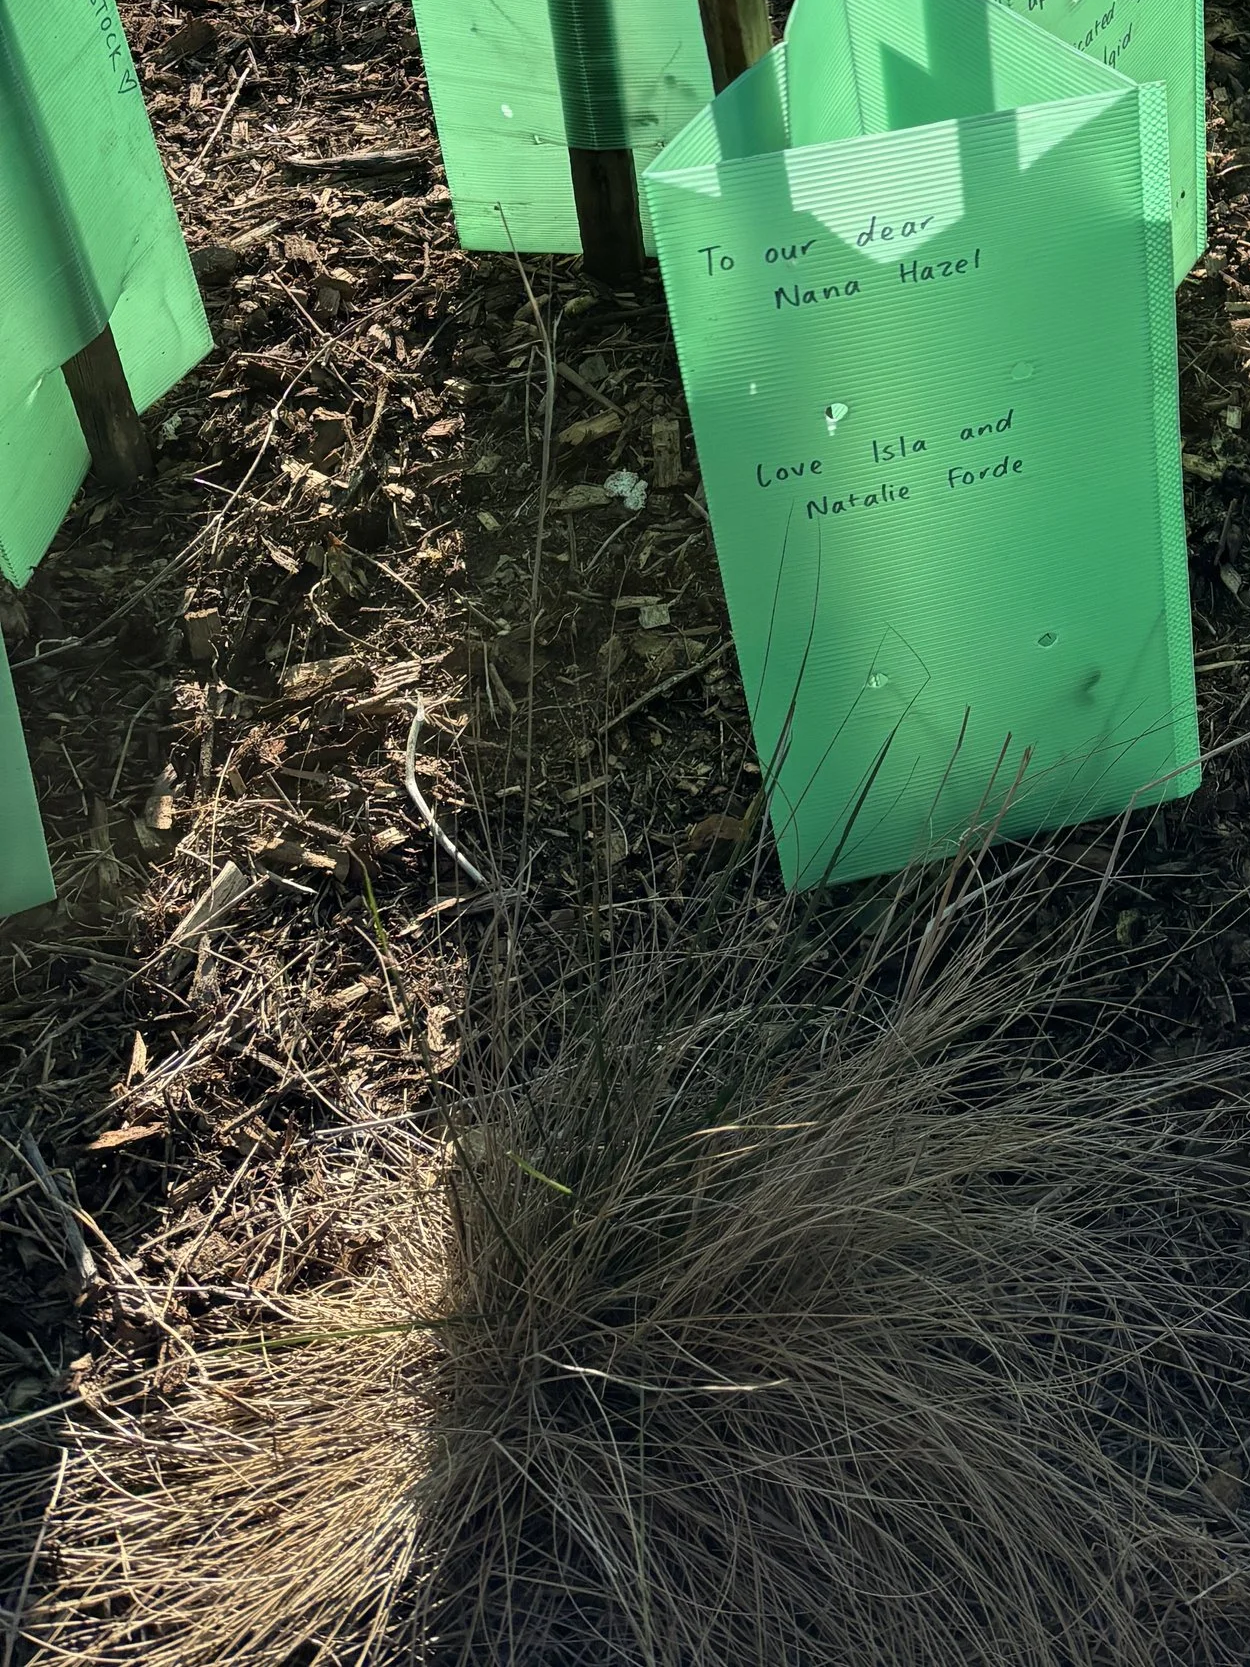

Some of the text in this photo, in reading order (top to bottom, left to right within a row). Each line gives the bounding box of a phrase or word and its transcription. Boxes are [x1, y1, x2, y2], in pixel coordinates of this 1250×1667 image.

[699, 214, 935, 277] To our dear
[773, 248, 982, 310] Nana Hazel
[756, 408, 1015, 488] Love Isla and
[805, 454, 1024, 520] Natalie Forde
